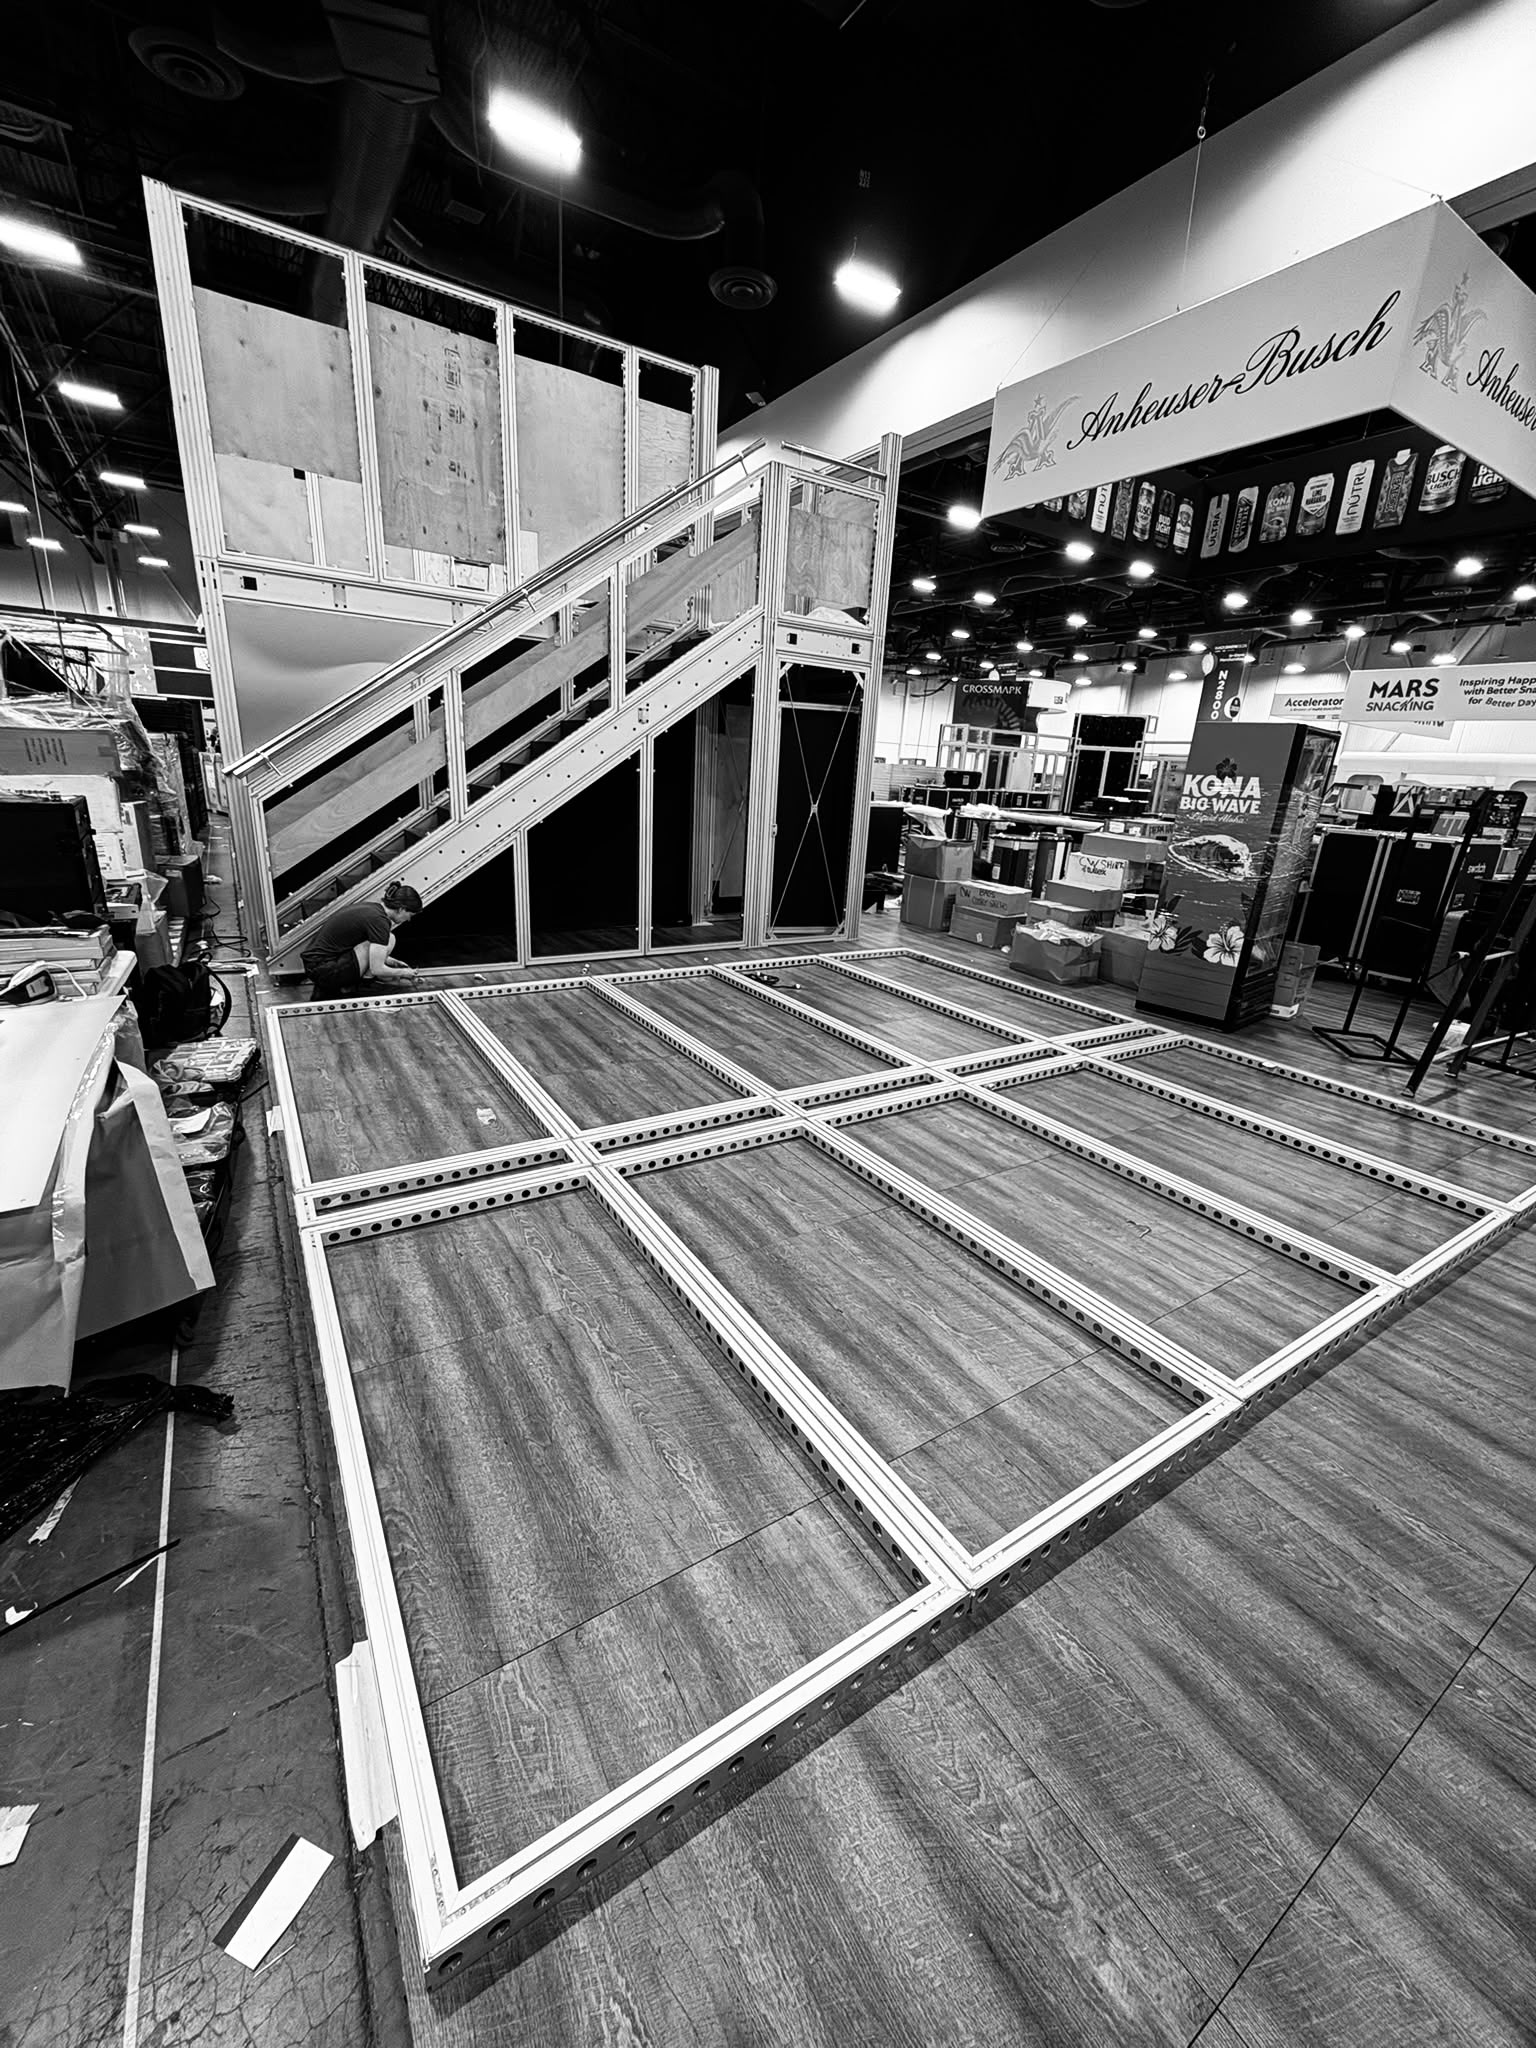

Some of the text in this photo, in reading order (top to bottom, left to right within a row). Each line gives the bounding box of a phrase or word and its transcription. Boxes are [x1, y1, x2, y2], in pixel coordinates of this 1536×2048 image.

[1066, 290, 1401, 450] Anheuser-Busch
[1425, 468, 1460, 485] BUSCH
[1207, 511, 1221, 547] ULTRA
[1369, 677, 1441, 698] MARS
[1459, 677, 1505, 688] Inspiring
[1464, 687, 1485, 695] with
[1486, 686, 1518, 695] Better
[1284, 697, 1344, 707] Accelerator
[1365, 697, 1435, 712] SNACKING
[1468, 696, 1483, 705] for
[1485, 697, 1516, 707] Better
[1183, 774, 1261, 799] KONA
[1212, 798, 1261, 815] WAVE
